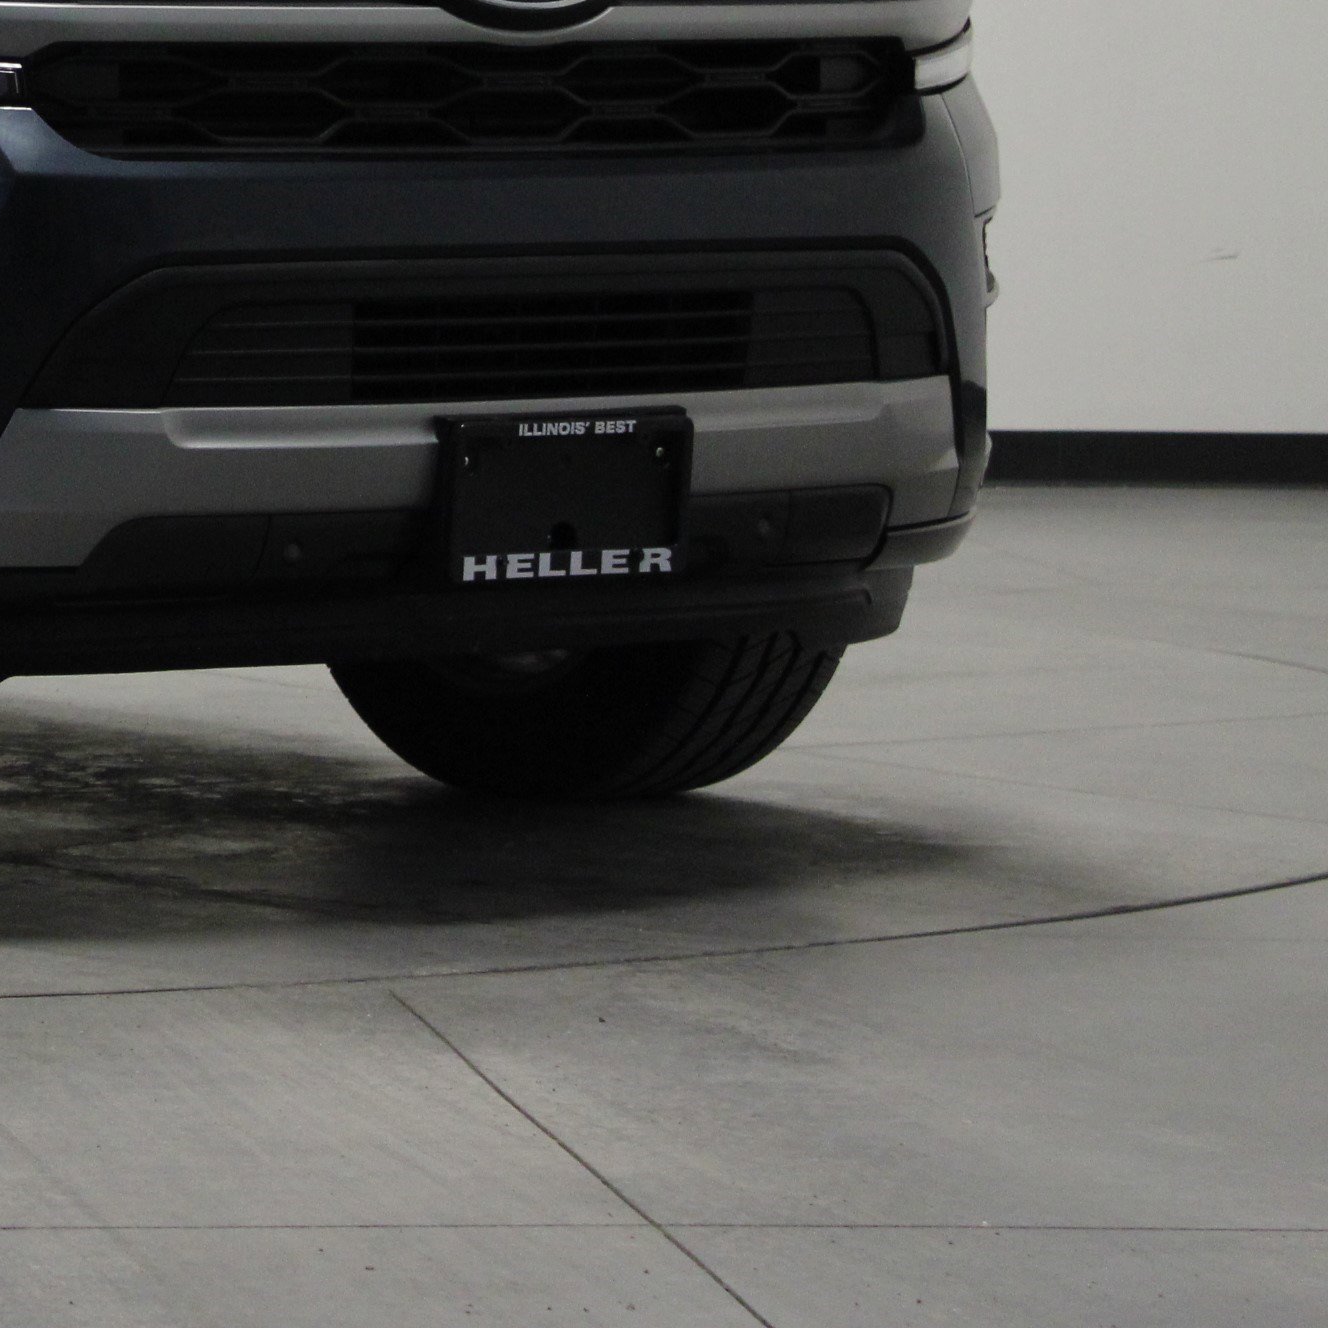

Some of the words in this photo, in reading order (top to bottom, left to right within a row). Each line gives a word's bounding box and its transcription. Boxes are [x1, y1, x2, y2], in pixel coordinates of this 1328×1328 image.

[518, 421, 591, 437] ILLINOIS'
[594, 420, 637, 434] BEST
[462, 547, 673, 581] HELLER
